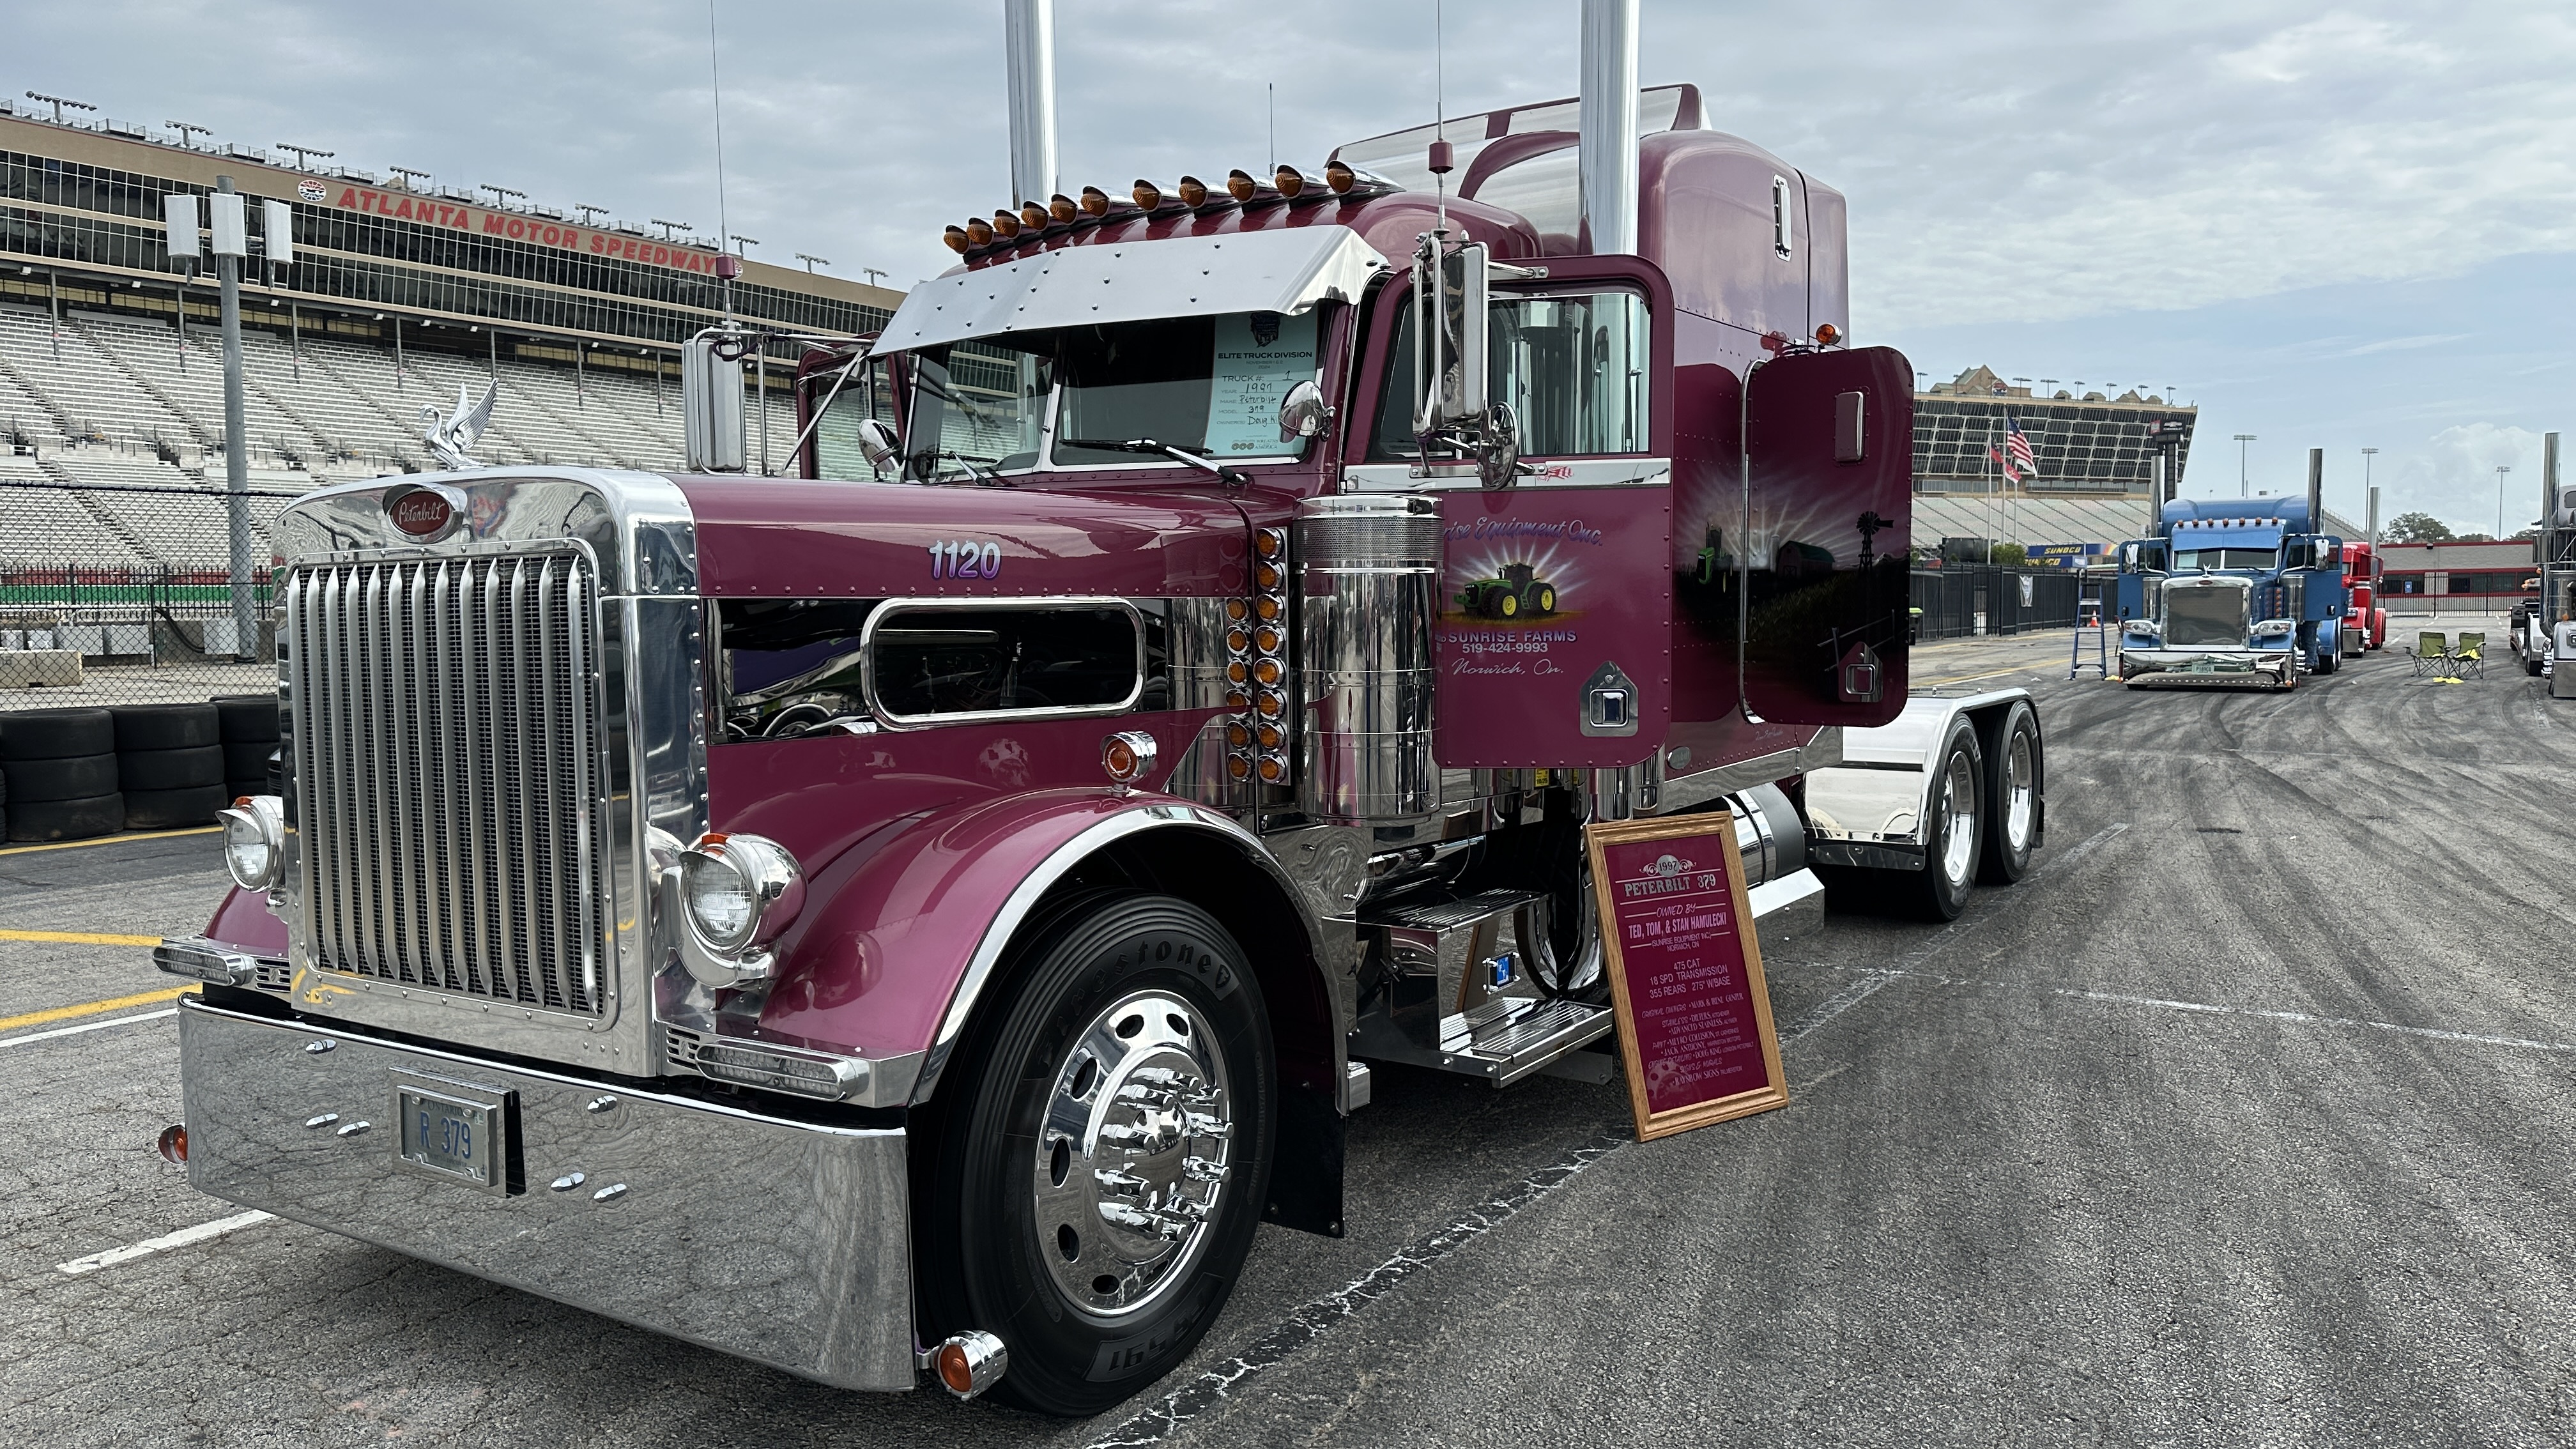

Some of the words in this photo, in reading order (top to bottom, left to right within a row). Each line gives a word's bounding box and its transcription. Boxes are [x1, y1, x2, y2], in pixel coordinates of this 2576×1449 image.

[338, 188, 469, 229] ATLANTA
[483, 214, 578, 249] MOTOR
[590, 234, 717, 274] SPEEDWAY
[1239, 394, 1276, 404] Peterbilt
[1248, 405, 1264, 413] 379
[1246, 415, 1268, 427] Doug
[399, 502, 445, 525] Peterbilt
[1474, 516, 1567, 542] Equipment
[2044, 546, 2082, 555] SUNOCO
[929, 540, 1000, 579] 1120
[1448, 631, 1517, 643] SUNRISE
[1524, 630, 1577, 643] FARMS
[1462, 643, 1549, 653] 519-424-9993
[1451, 658, 1526, 675] Norwich,
[1659, 861, 1677, 871] 1997
[1624, 877, 1691, 897] PETERBILT
[1697, 873, 1716, 890] 379
[1656, 904, 1683, 918] OWNED
[1685, 903, 1696, 914] BY
[1629, 924, 1644, 940] TED,
[1646, 921, 1664, 937] TOM,
[1665, 919, 1671, 933] &
[1672, 917, 1689, 933] STAN
[1691, 912, 1727, 930] HAMULECKI
[1673, 933, 1701, 944] EQUIPMENT
[1673, 961, 1686, 970] 475
[1687, 958, 1700, 969] CAT
[1650, 976, 1658, 986] 18
[1659, 973, 1674, 985] SPD
[1676, 963, 1728, 981] TRANSMISSION
[1650, 989, 1662, 999] 355
[1663, 984, 1687, 996] REARS
[1706, 976, 1731, 989] W/BASE
[1706, 998, 1711, 1007] &
[1709, 1046, 1722, 1055] KING
[1696, 1061, 1701, 1071] &
[427, 1099, 463, 1116] ONTARIO
[420, 1110, 431, 1149] R
[440, 1117, 471, 1160] 379
